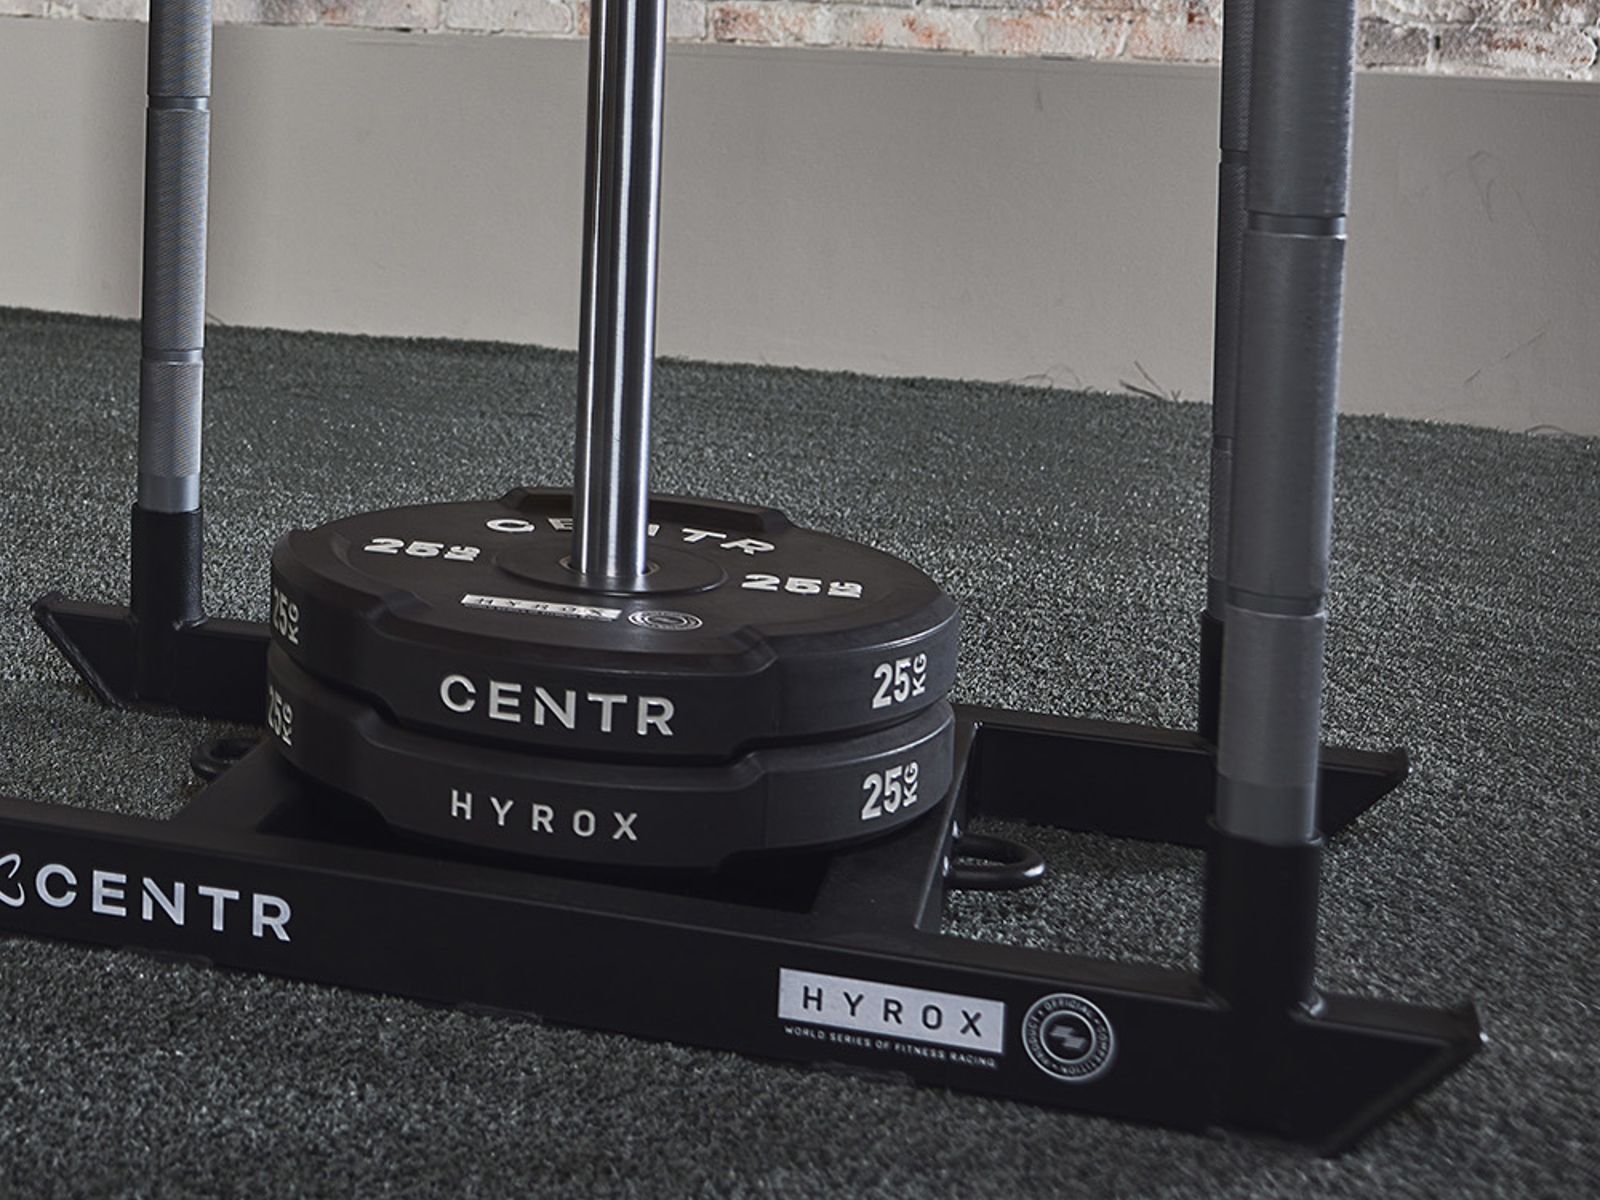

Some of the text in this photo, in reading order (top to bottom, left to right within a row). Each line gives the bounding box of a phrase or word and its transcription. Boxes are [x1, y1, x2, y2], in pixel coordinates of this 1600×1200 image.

[364, 538, 445, 558] 25
[486, 518, 775, 555] CETR
[741, 573, 823, 595] 25
[440, 674, 675, 736] CENTR
[871, 652, 928, 709] 25 KG
[451, 789, 639, 842] HYROX
[861, 761, 919, 821] 25 KG
[34, 862, 293, 943] CENTR
[802, 985, 983, 1039] HYROX
[784, 1025, 998, 1069] WORLD SERIES OF FITNESS RACING
